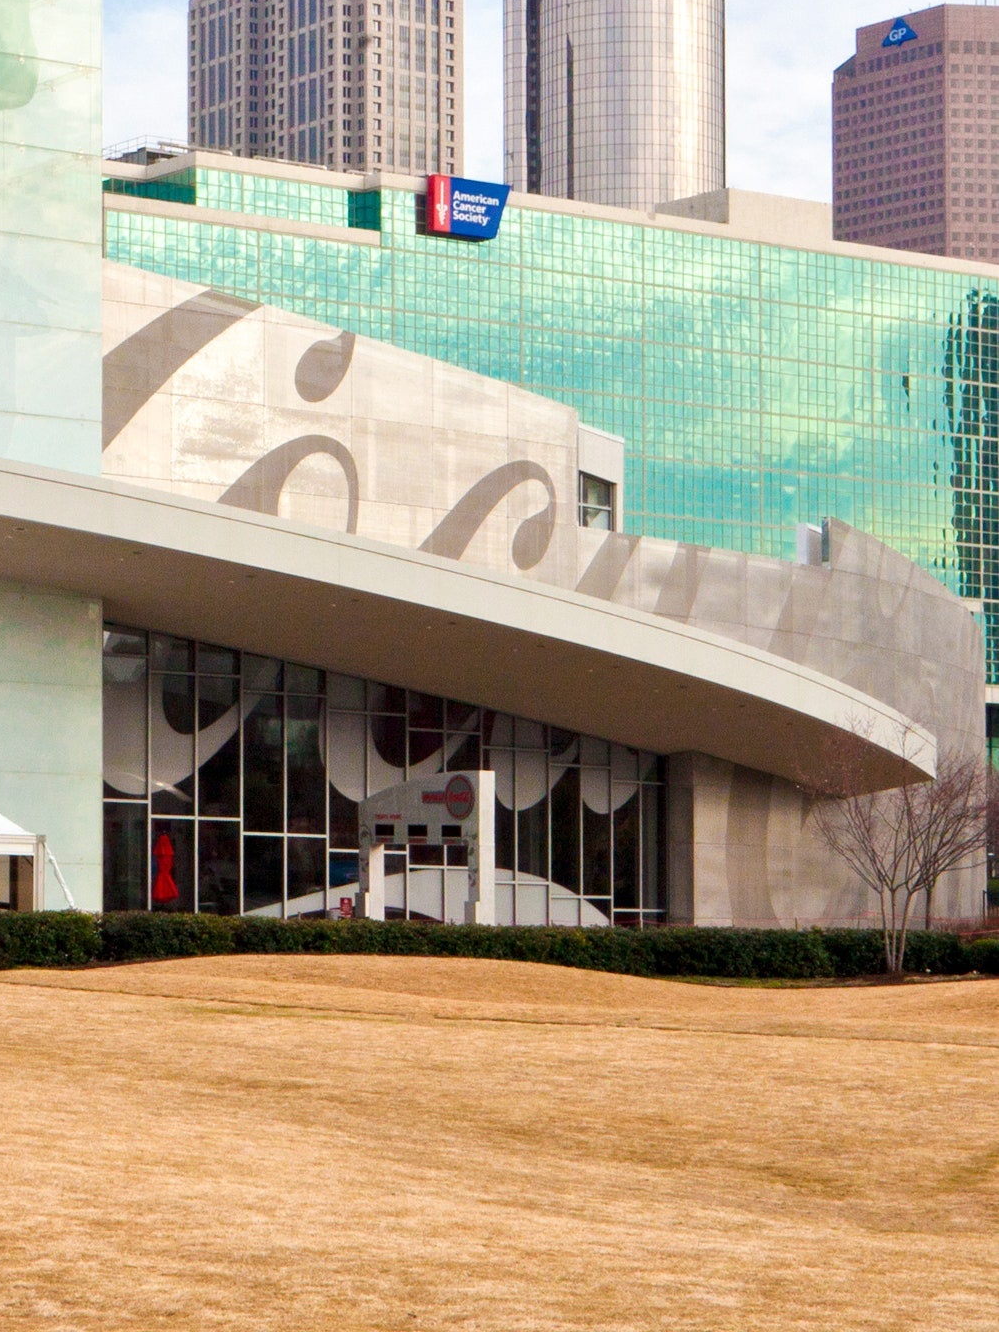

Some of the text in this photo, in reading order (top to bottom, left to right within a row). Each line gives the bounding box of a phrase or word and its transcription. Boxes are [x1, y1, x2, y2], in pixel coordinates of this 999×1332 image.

[889, 28, 906, 41] GP
[453, 191, 499, 206] American
[453, 201, 486, 214] Cancer
[453, 210, 488, 226] Society
